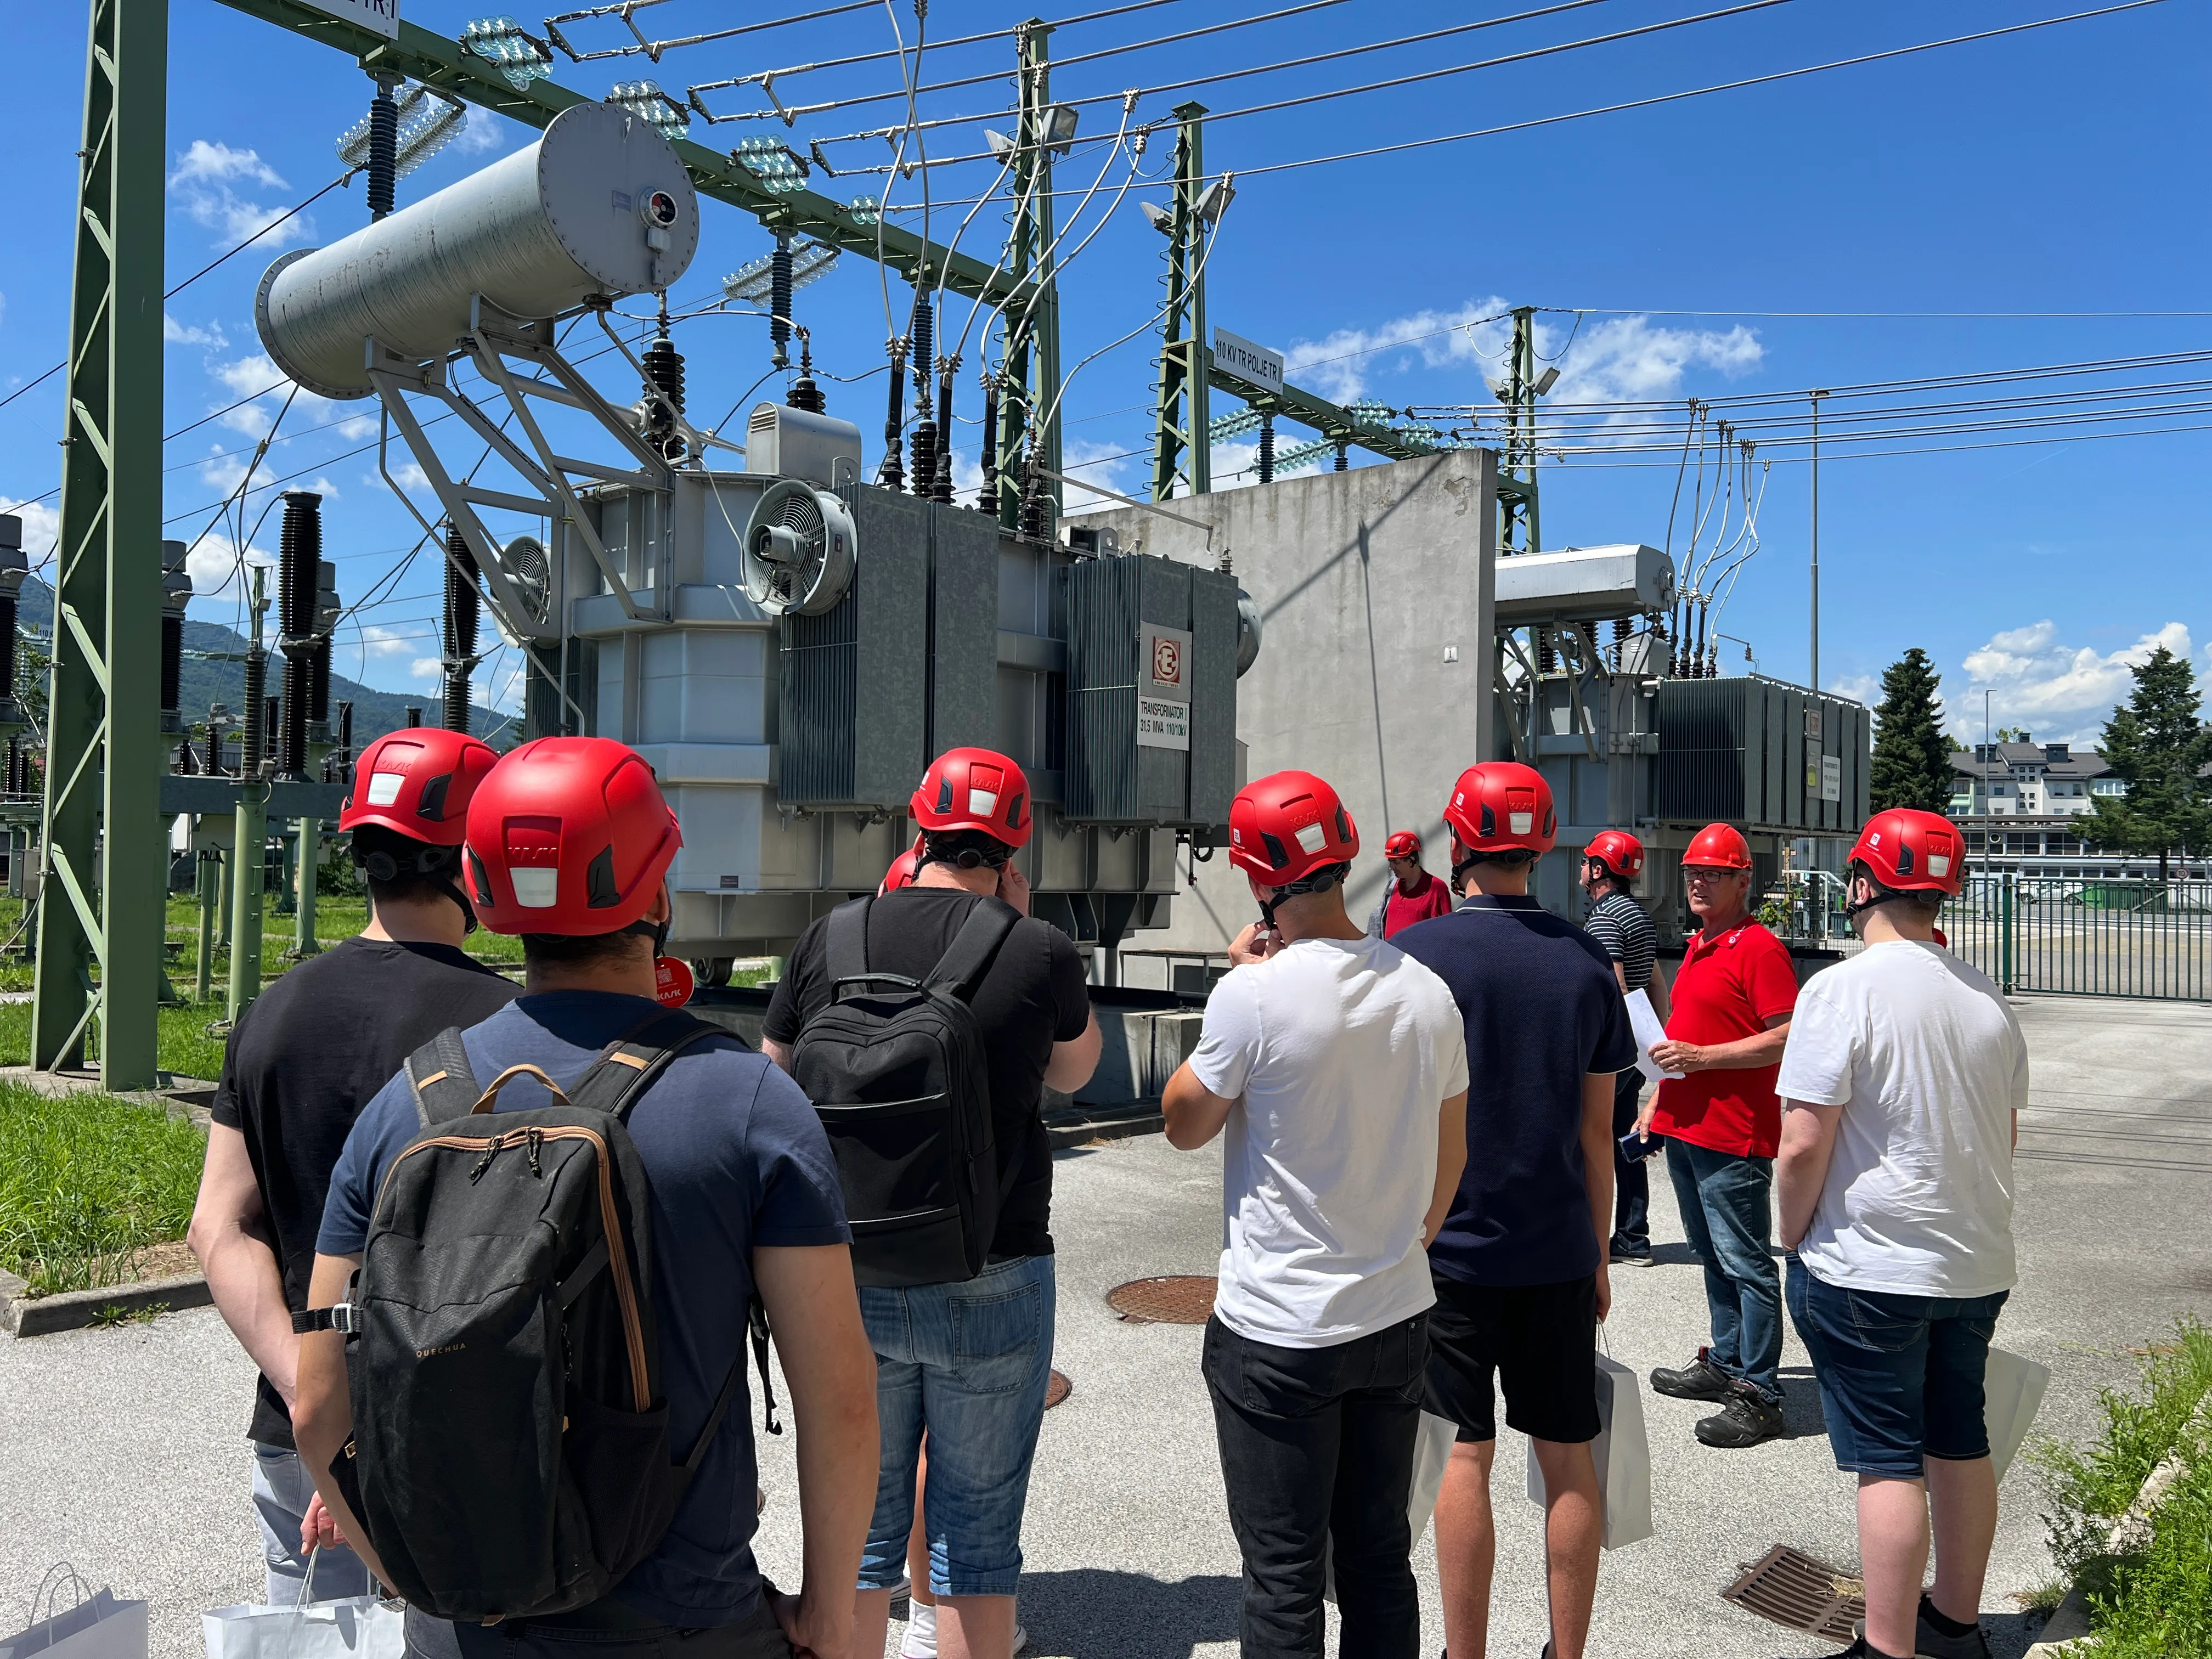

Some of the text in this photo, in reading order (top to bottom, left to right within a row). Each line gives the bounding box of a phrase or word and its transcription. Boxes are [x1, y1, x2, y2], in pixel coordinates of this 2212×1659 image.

[1216, 338, 1227, 359] 110
[1227, 343, 1238, 363] KV
[1238, 348, 1246, 368] TR
[1247, 353, 1267, 377] POLJE
[1269, 362, 1277, 382] TR
[1449, 650, 1452, 658] 1
[1141, 701, 1188, 721] TRANSFORMATOR I
[1140, 719, 1187, 737] 31,5 MVA 110/10kV
[657, 989, 681, 1001] KASK
[416, 1342, 466, 1358] QUECHUA
